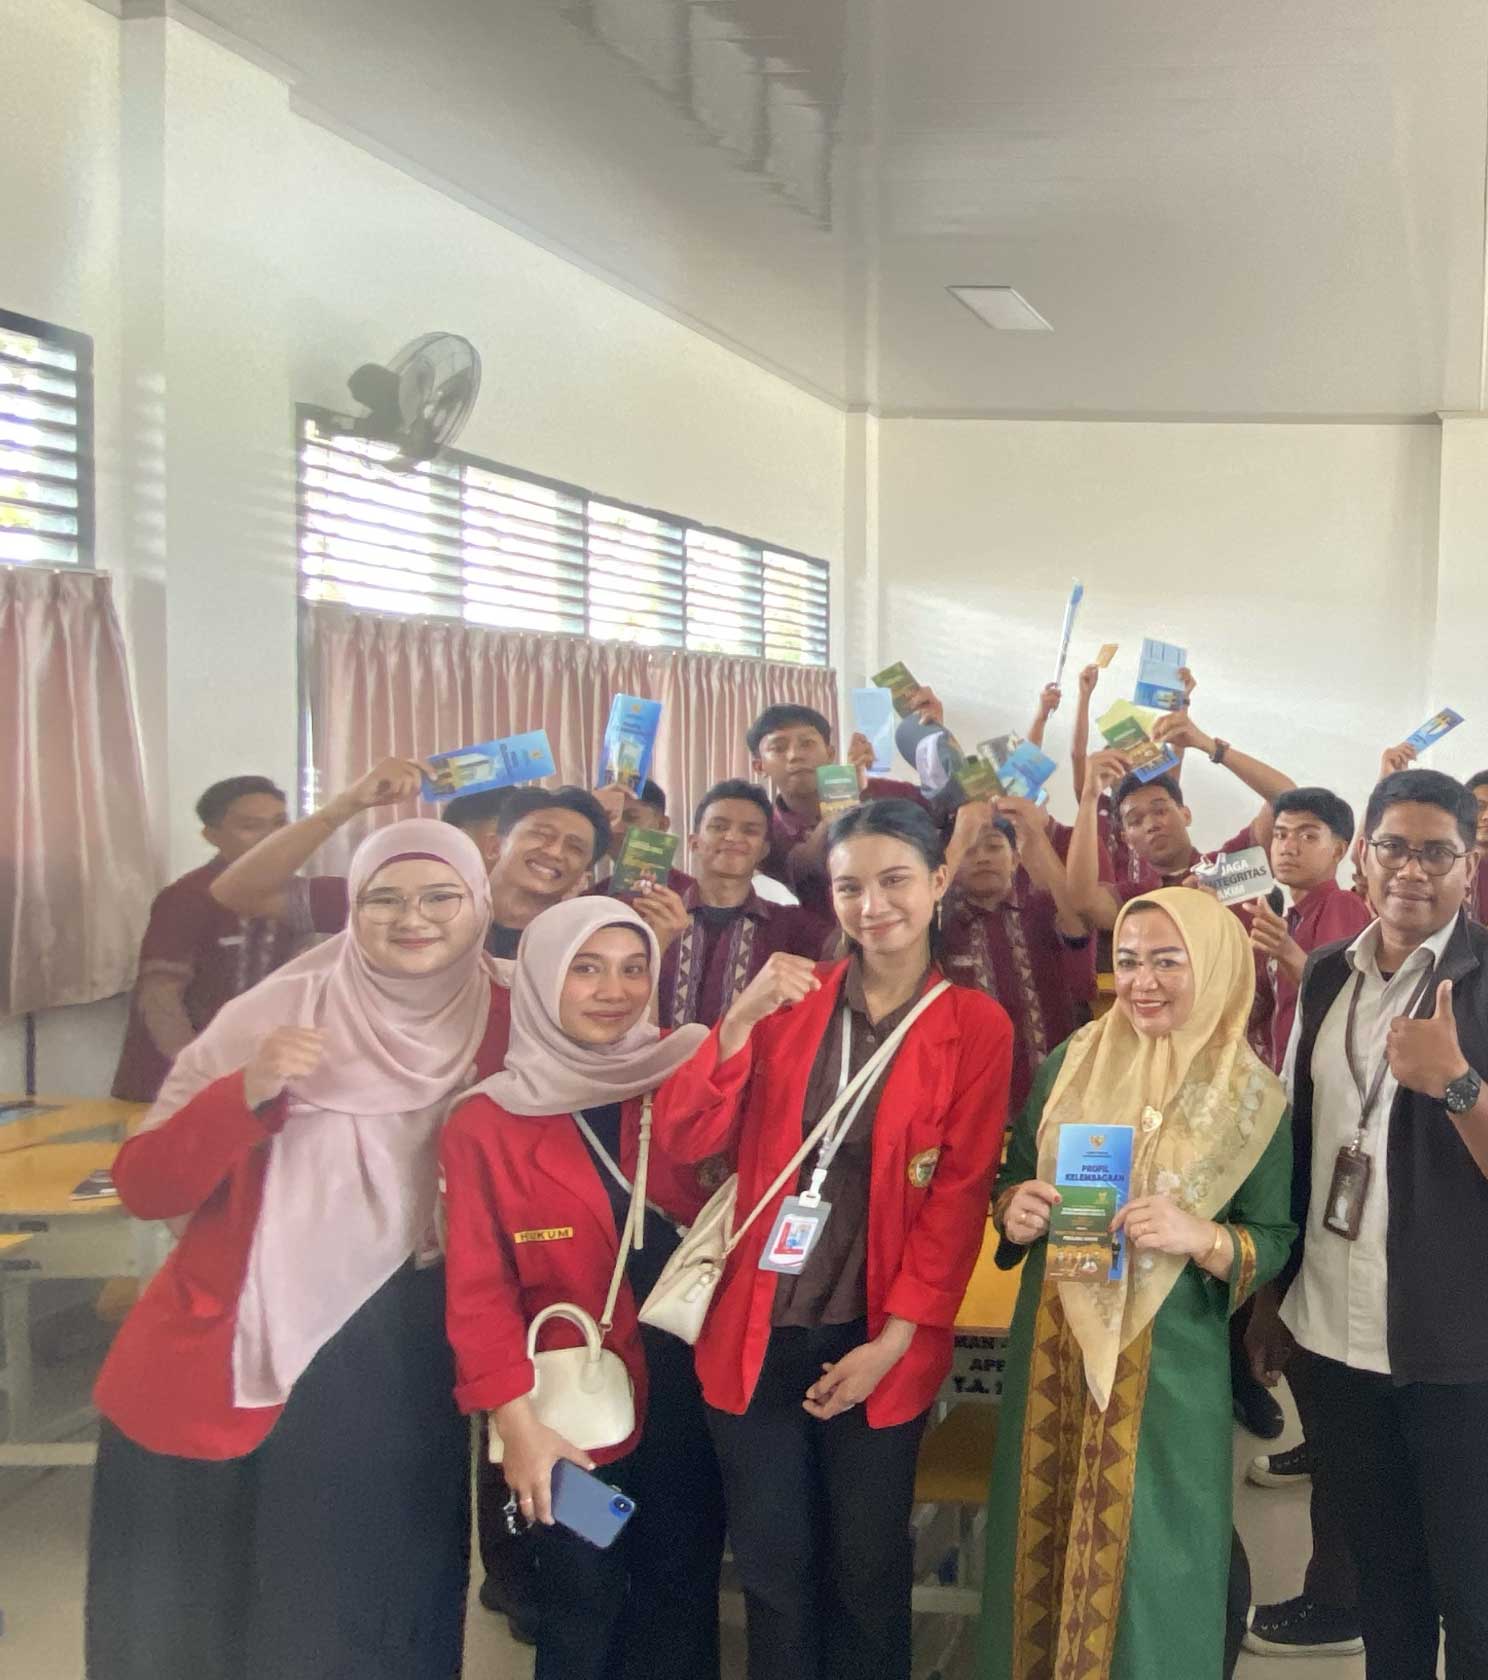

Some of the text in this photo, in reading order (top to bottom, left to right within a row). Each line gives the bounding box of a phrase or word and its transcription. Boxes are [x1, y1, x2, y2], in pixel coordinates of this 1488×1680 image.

[1221, 859, 1249, 876] JAGA
[1081, 1164, 1109, 1173] PROFIL
[520, 1229, 569, 1241] HUKUM
